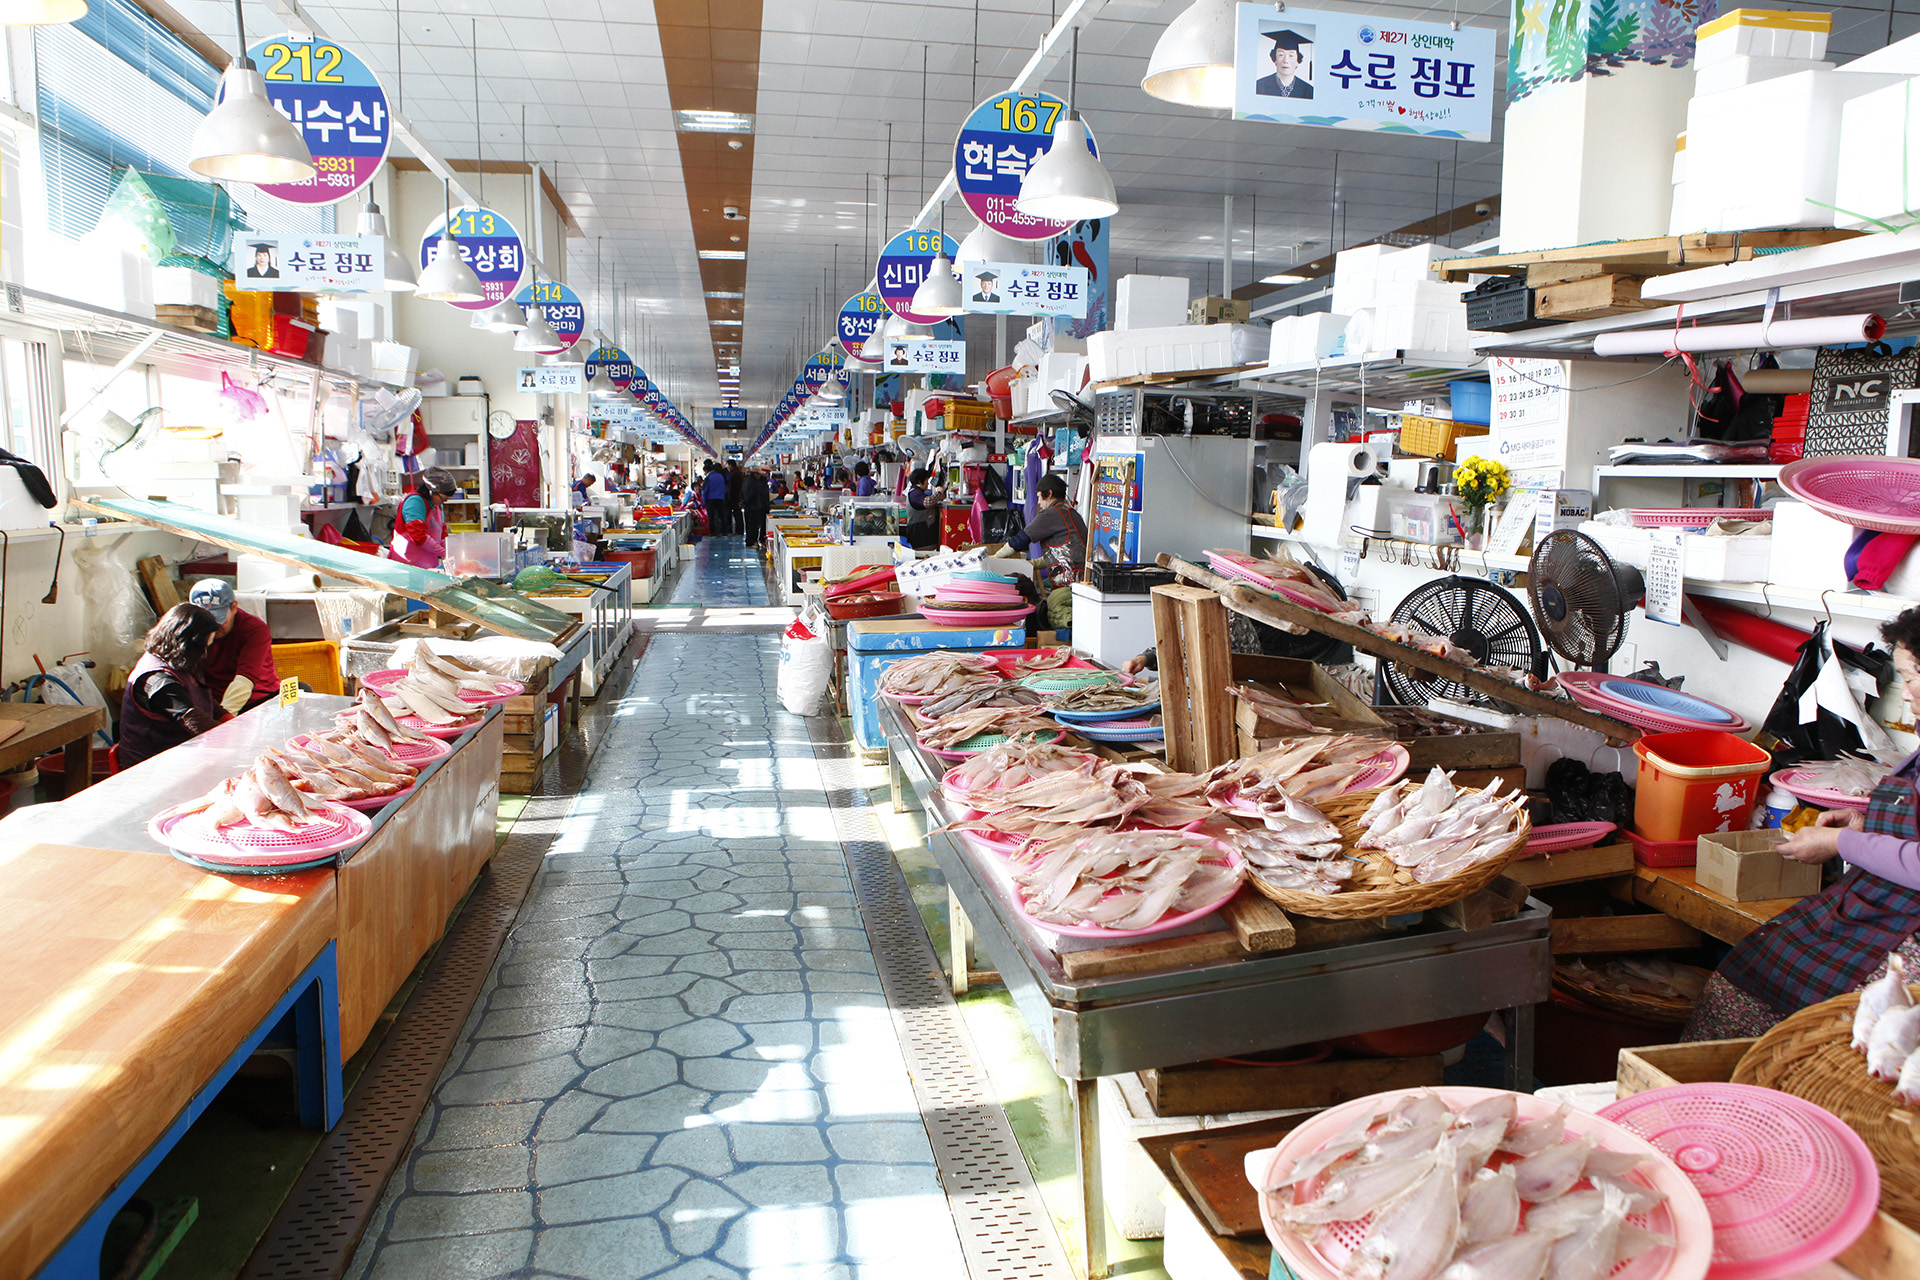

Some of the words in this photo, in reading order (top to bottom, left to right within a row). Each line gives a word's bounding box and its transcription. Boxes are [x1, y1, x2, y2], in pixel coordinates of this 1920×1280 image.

[1379, 30, 1407, 44] 제2기
[1410, 34, 1454, 51] 상인대학
[263, 43, 344, 83] 212
[1330, 49, 1397, 90] 수료
[1410, 56, 1476, 98] 점포
[994, 97, 1063, 134] 167
[449, 214, 495, 235] 213
[905, 235, 941, 252] 166
[287, 251, 327, 272] 수료
[334, 252, 374, 274] 점포
[530, 284, 563, 301] 214
[1007, 280, 1040, 298] 수료
[1046, 281, 1079, 301] 점포
[598, 349, 619, 360] 215
[816, 354, 839, 365] 164
[913, 350, 934, 362] 수료
[938, 350, 960, 363] 점포
[540, 375, 556, 385] 수료
[560, 375, 576, 385] 점포
[806, 367, 849, 382] 서울회
[1496, 376, 1506, 385] 15
[1509, 375, 1517, 383] 16
[1520, 373, 1526, 381] 17
[1536, 369, 1542, 378] 19
[1544, 368, 1551, 377] 20
[1554, 365, 1560, 374] 21
[1498, 394, 1507, 402] 22
[1509, 393, 1517, 401] 23
[1519, 391, 1526, 399] 24
[1527, 389, 1534, 398] 25
[1535, 388, 1541, 396] 26
[1543, 386, 1550, 395] 27
[1834, 380, 1882, 400] NC
[1499, 411, 1508, 420] 29
[1509, 410, 1516, 418] 30
[1519, 409, 1525, 417] 31
[1560, 508, 1585, 517] NOBAC
